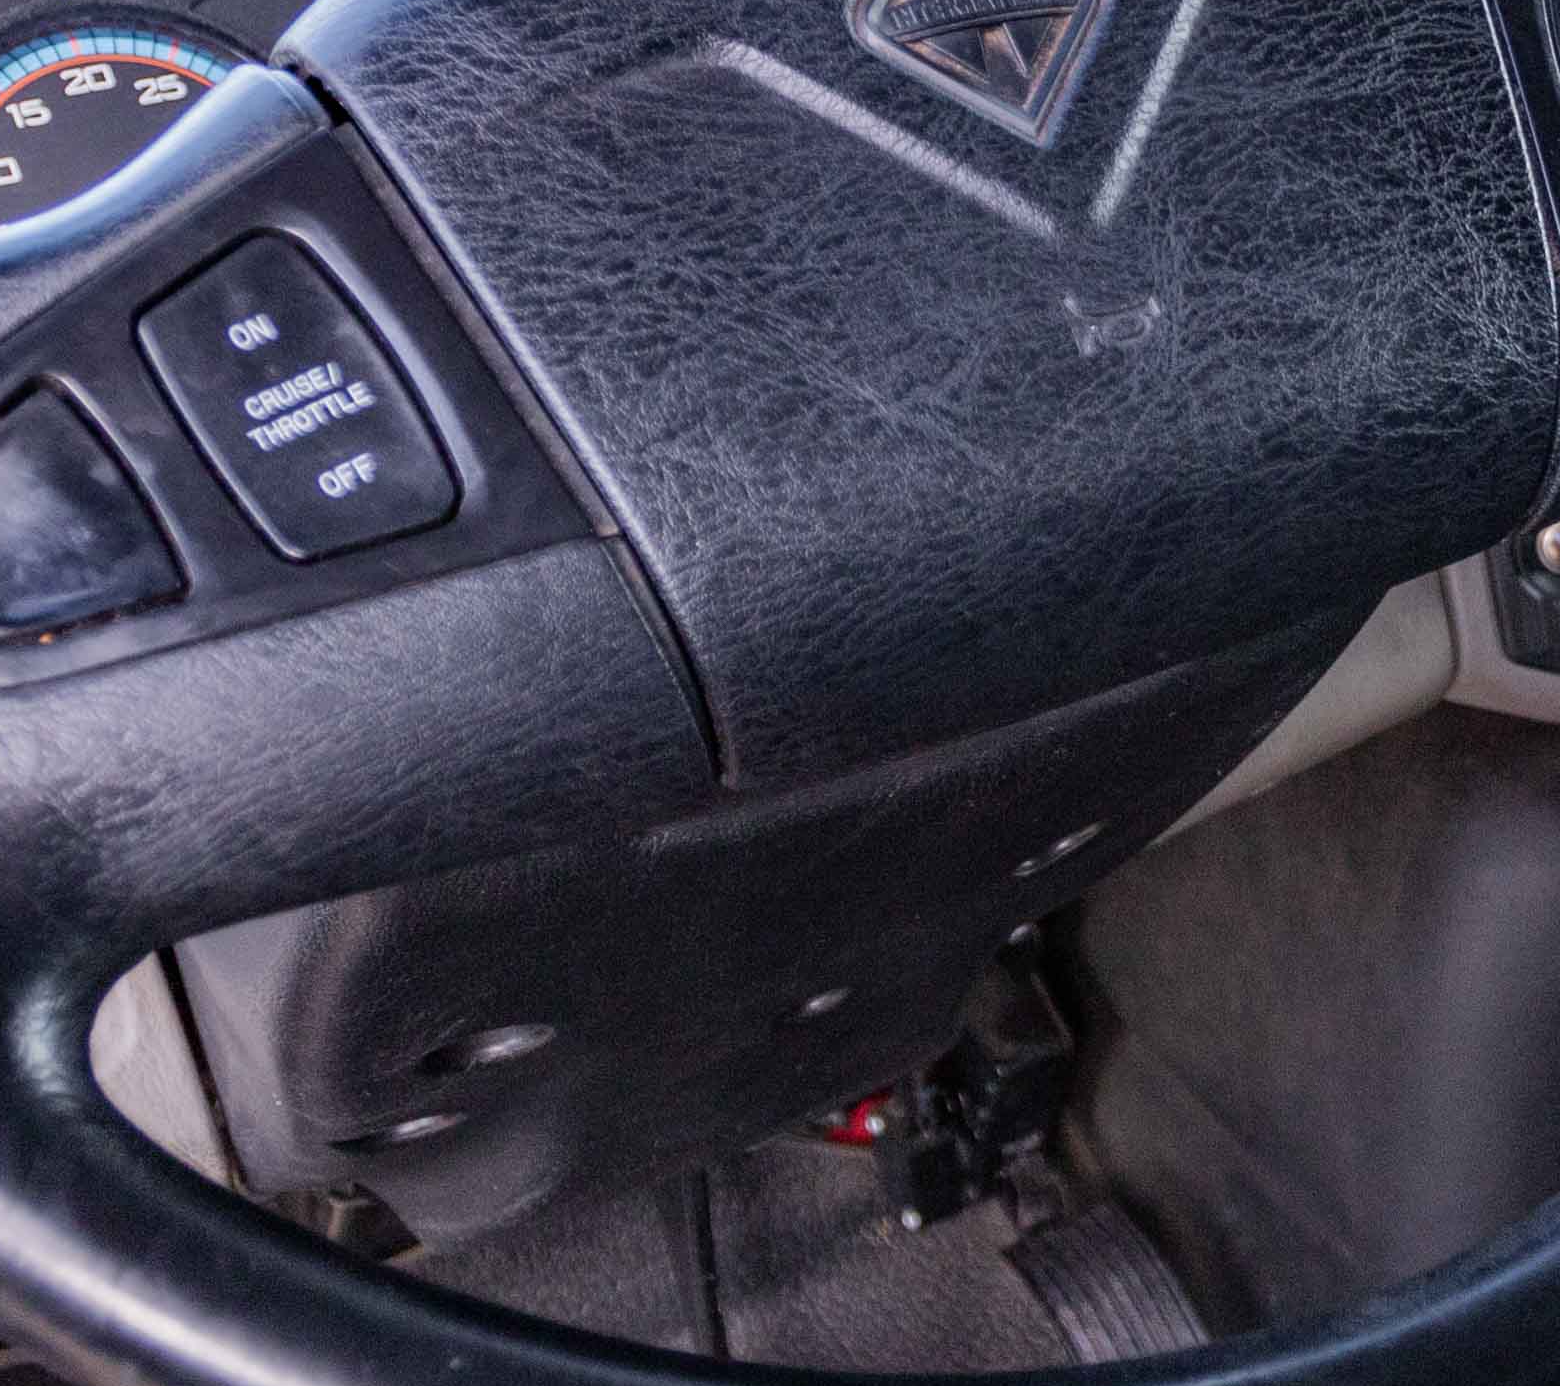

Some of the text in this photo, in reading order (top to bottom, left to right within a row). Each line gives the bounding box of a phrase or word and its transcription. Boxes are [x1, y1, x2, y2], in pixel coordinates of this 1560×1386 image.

[59, 63, 117, 97] 20
[133, 73, 189, 106] 25
[5, 98, 53, 130] 15
[227, 313, 279, 351] ON
[243, 361, 343, 420] CRUISE/
[246, 380, 378, 451] THROTTLE
[317, 452, 378, 498] OFF
